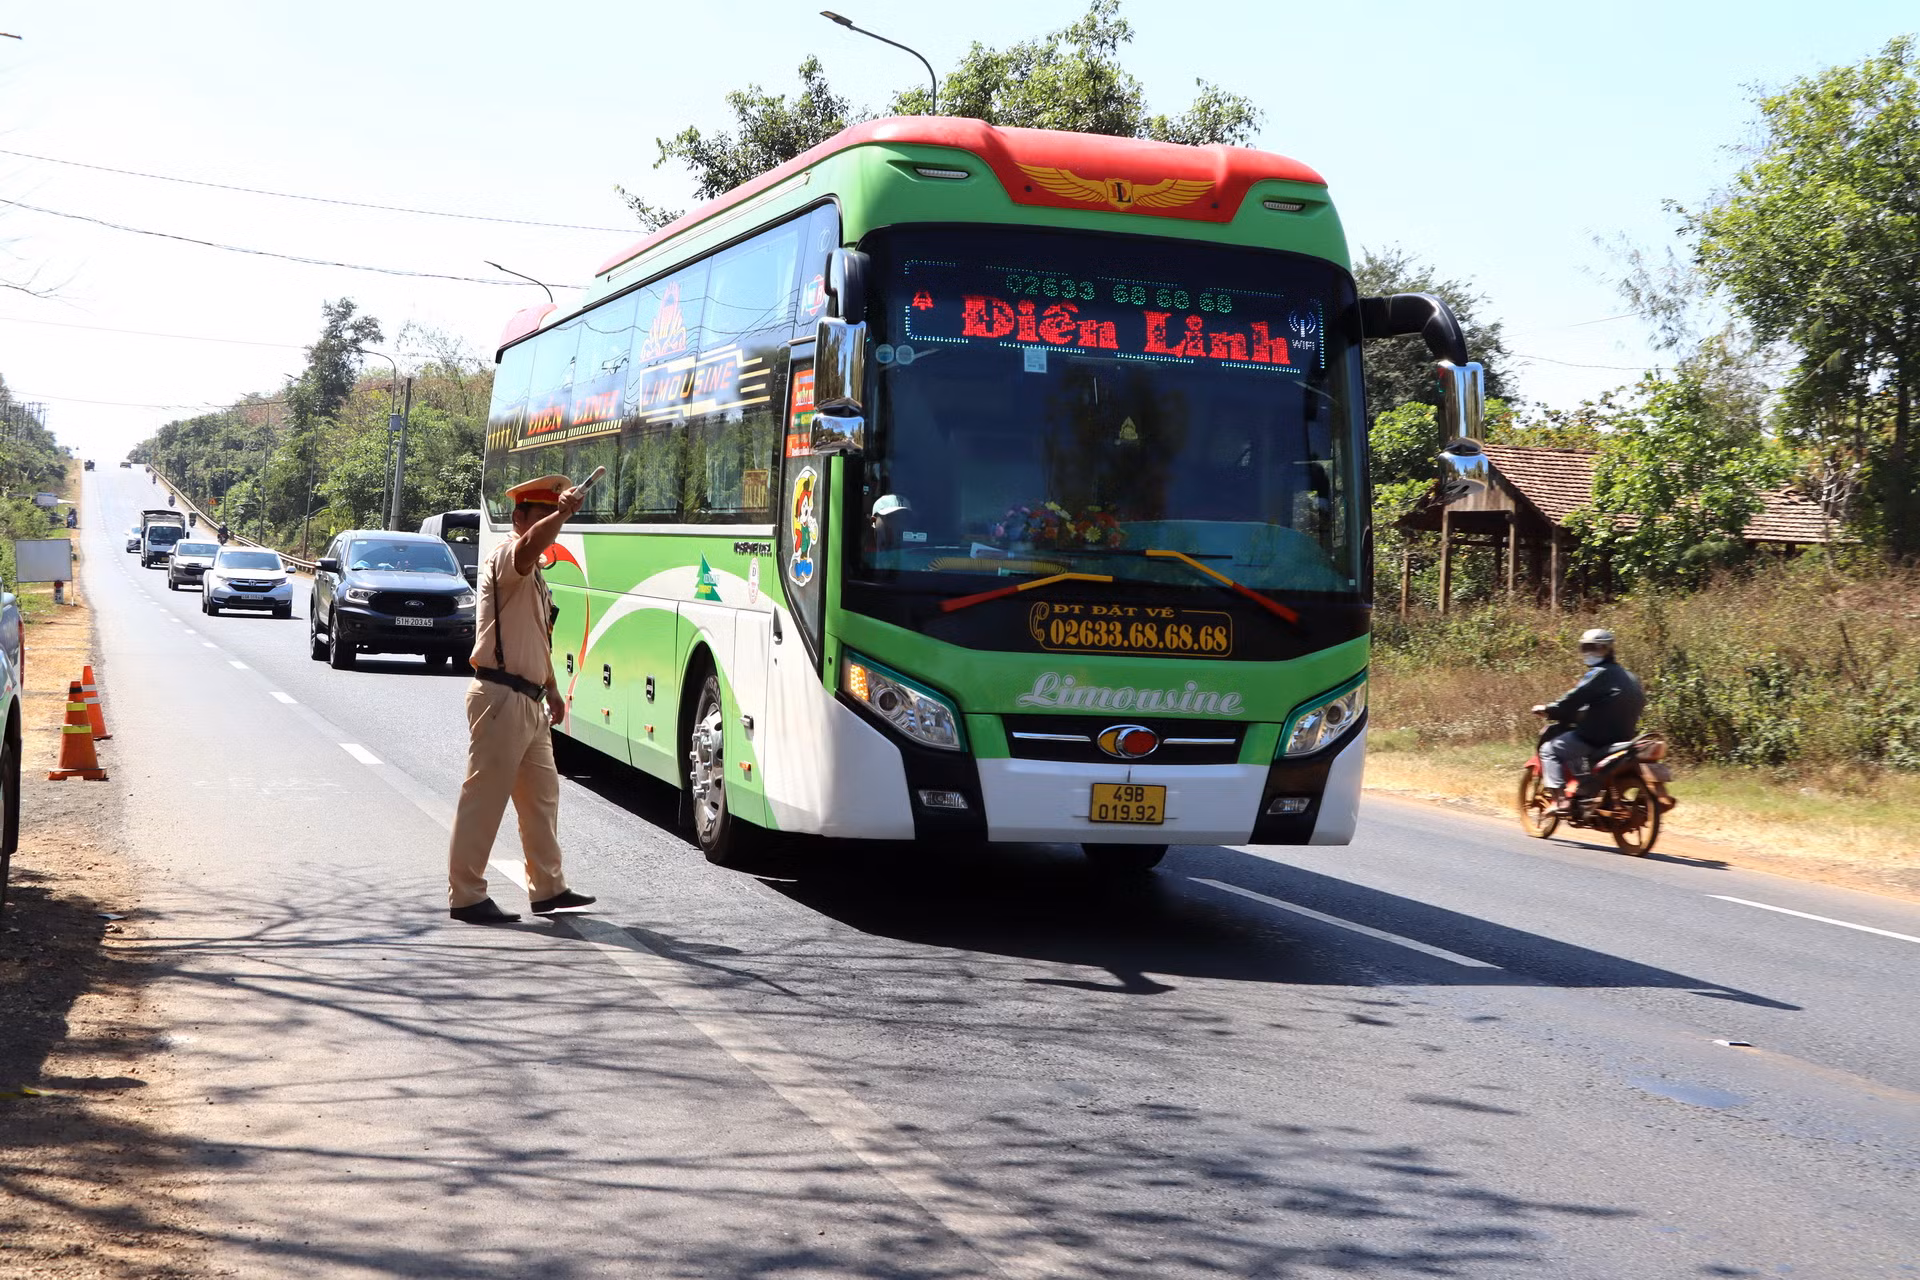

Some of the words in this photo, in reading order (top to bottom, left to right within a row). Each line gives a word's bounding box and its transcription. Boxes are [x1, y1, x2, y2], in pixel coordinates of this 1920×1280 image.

[1006, 274, 1095, 300] 02633
[1112, 284, 1147, 305] 68
[1156, 288, 1190, 309] 68
[1199, 292, 1233, 313] 68
[1144, 310, 1291, 364] Linh
[1291, 339, 1315, 351] WIFI
[642, 361, 736, 407] LIMOUSINE
[571, 389, 620, 425] LINH
[1053, 604, 1085, 614] ĐT
[1091, 604, 1138, 618] ĐẶT
[1050, 618, 1228, 652] 02633.68.68.68
[1016, 671, 1245, 716] Limousine
[1113, 786, 1145, 802] 49B
[1098, 804, 1157, 821] 019.92
